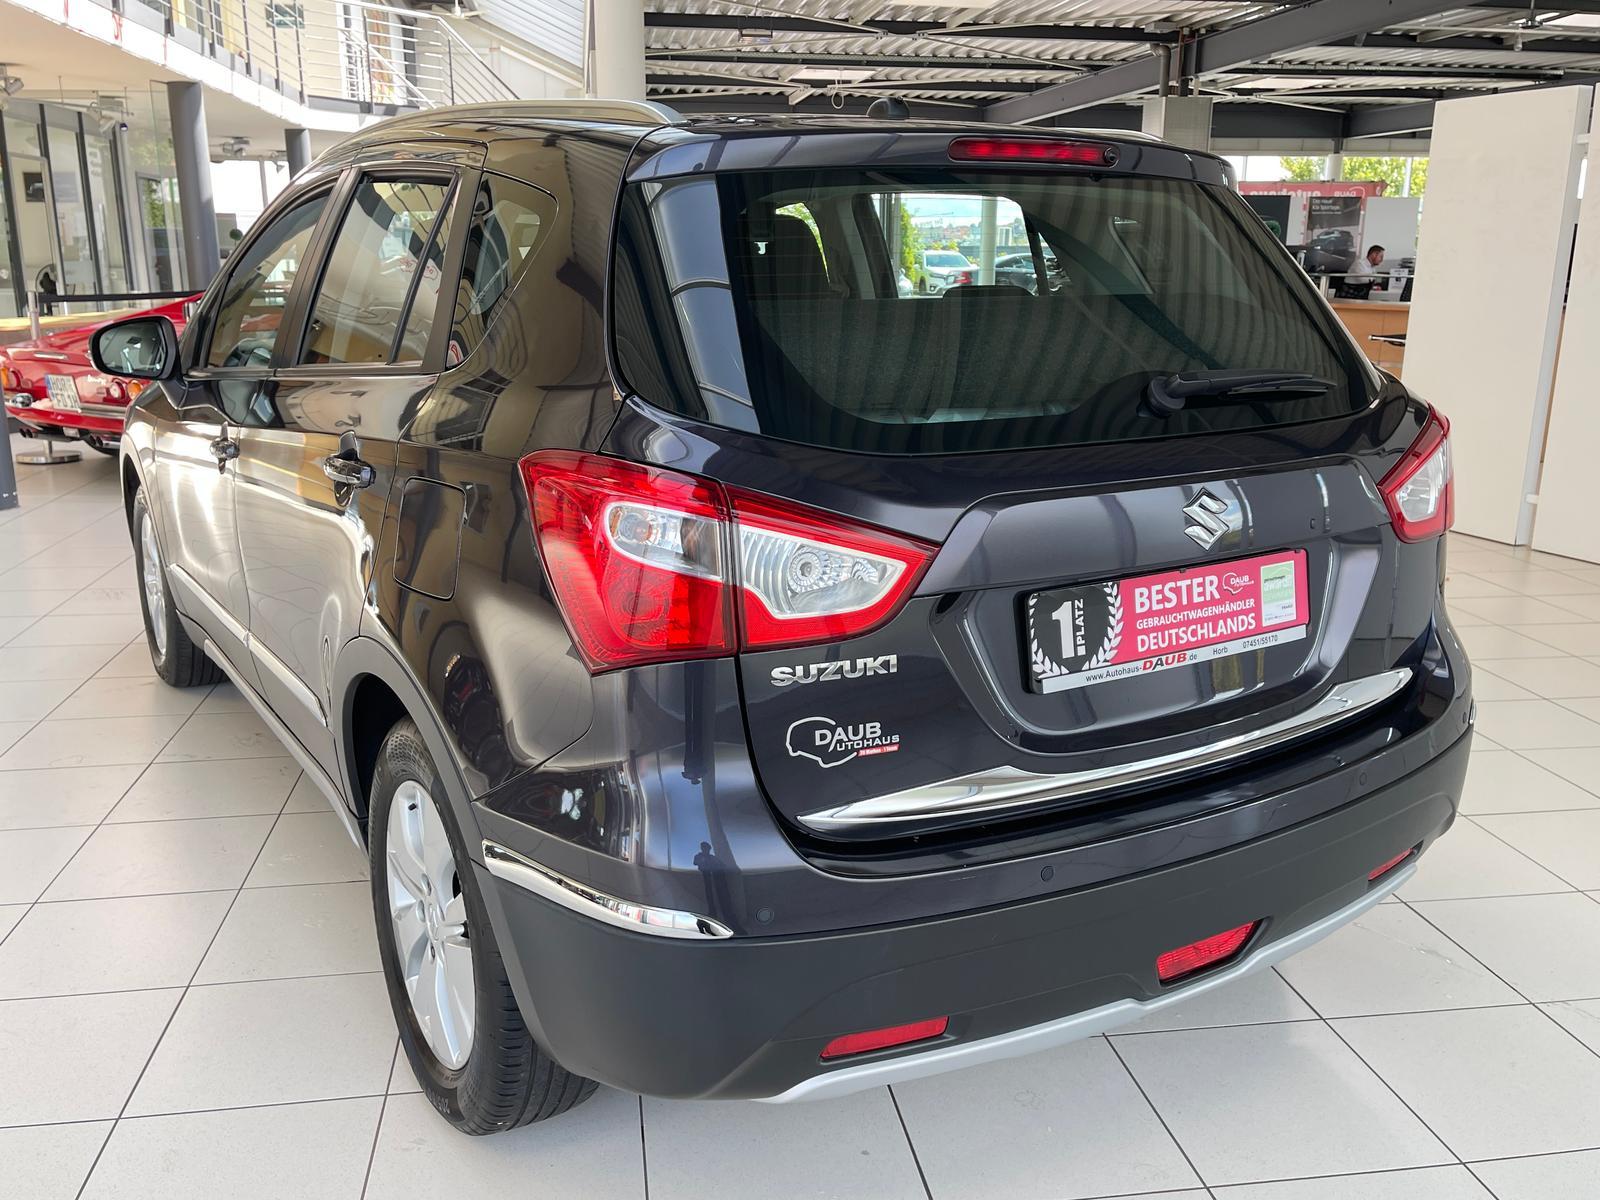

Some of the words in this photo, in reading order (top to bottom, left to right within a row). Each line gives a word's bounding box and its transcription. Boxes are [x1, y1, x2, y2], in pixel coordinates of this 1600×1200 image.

[1134, 575, 1220, 614] BESTER
[1136, 598, 1255, 630] GEBRAUCHTWAGENHÄNDLER
[1137, 612, 1256, 652] DEUTSCHLANDS
[1212, 646, 1229, 655] Horb
[1242, 634, 1279, 649] 07451/55170
[770, 654, 898, 687] SUZUKI
[814, 722, 882, 752] DAUB
